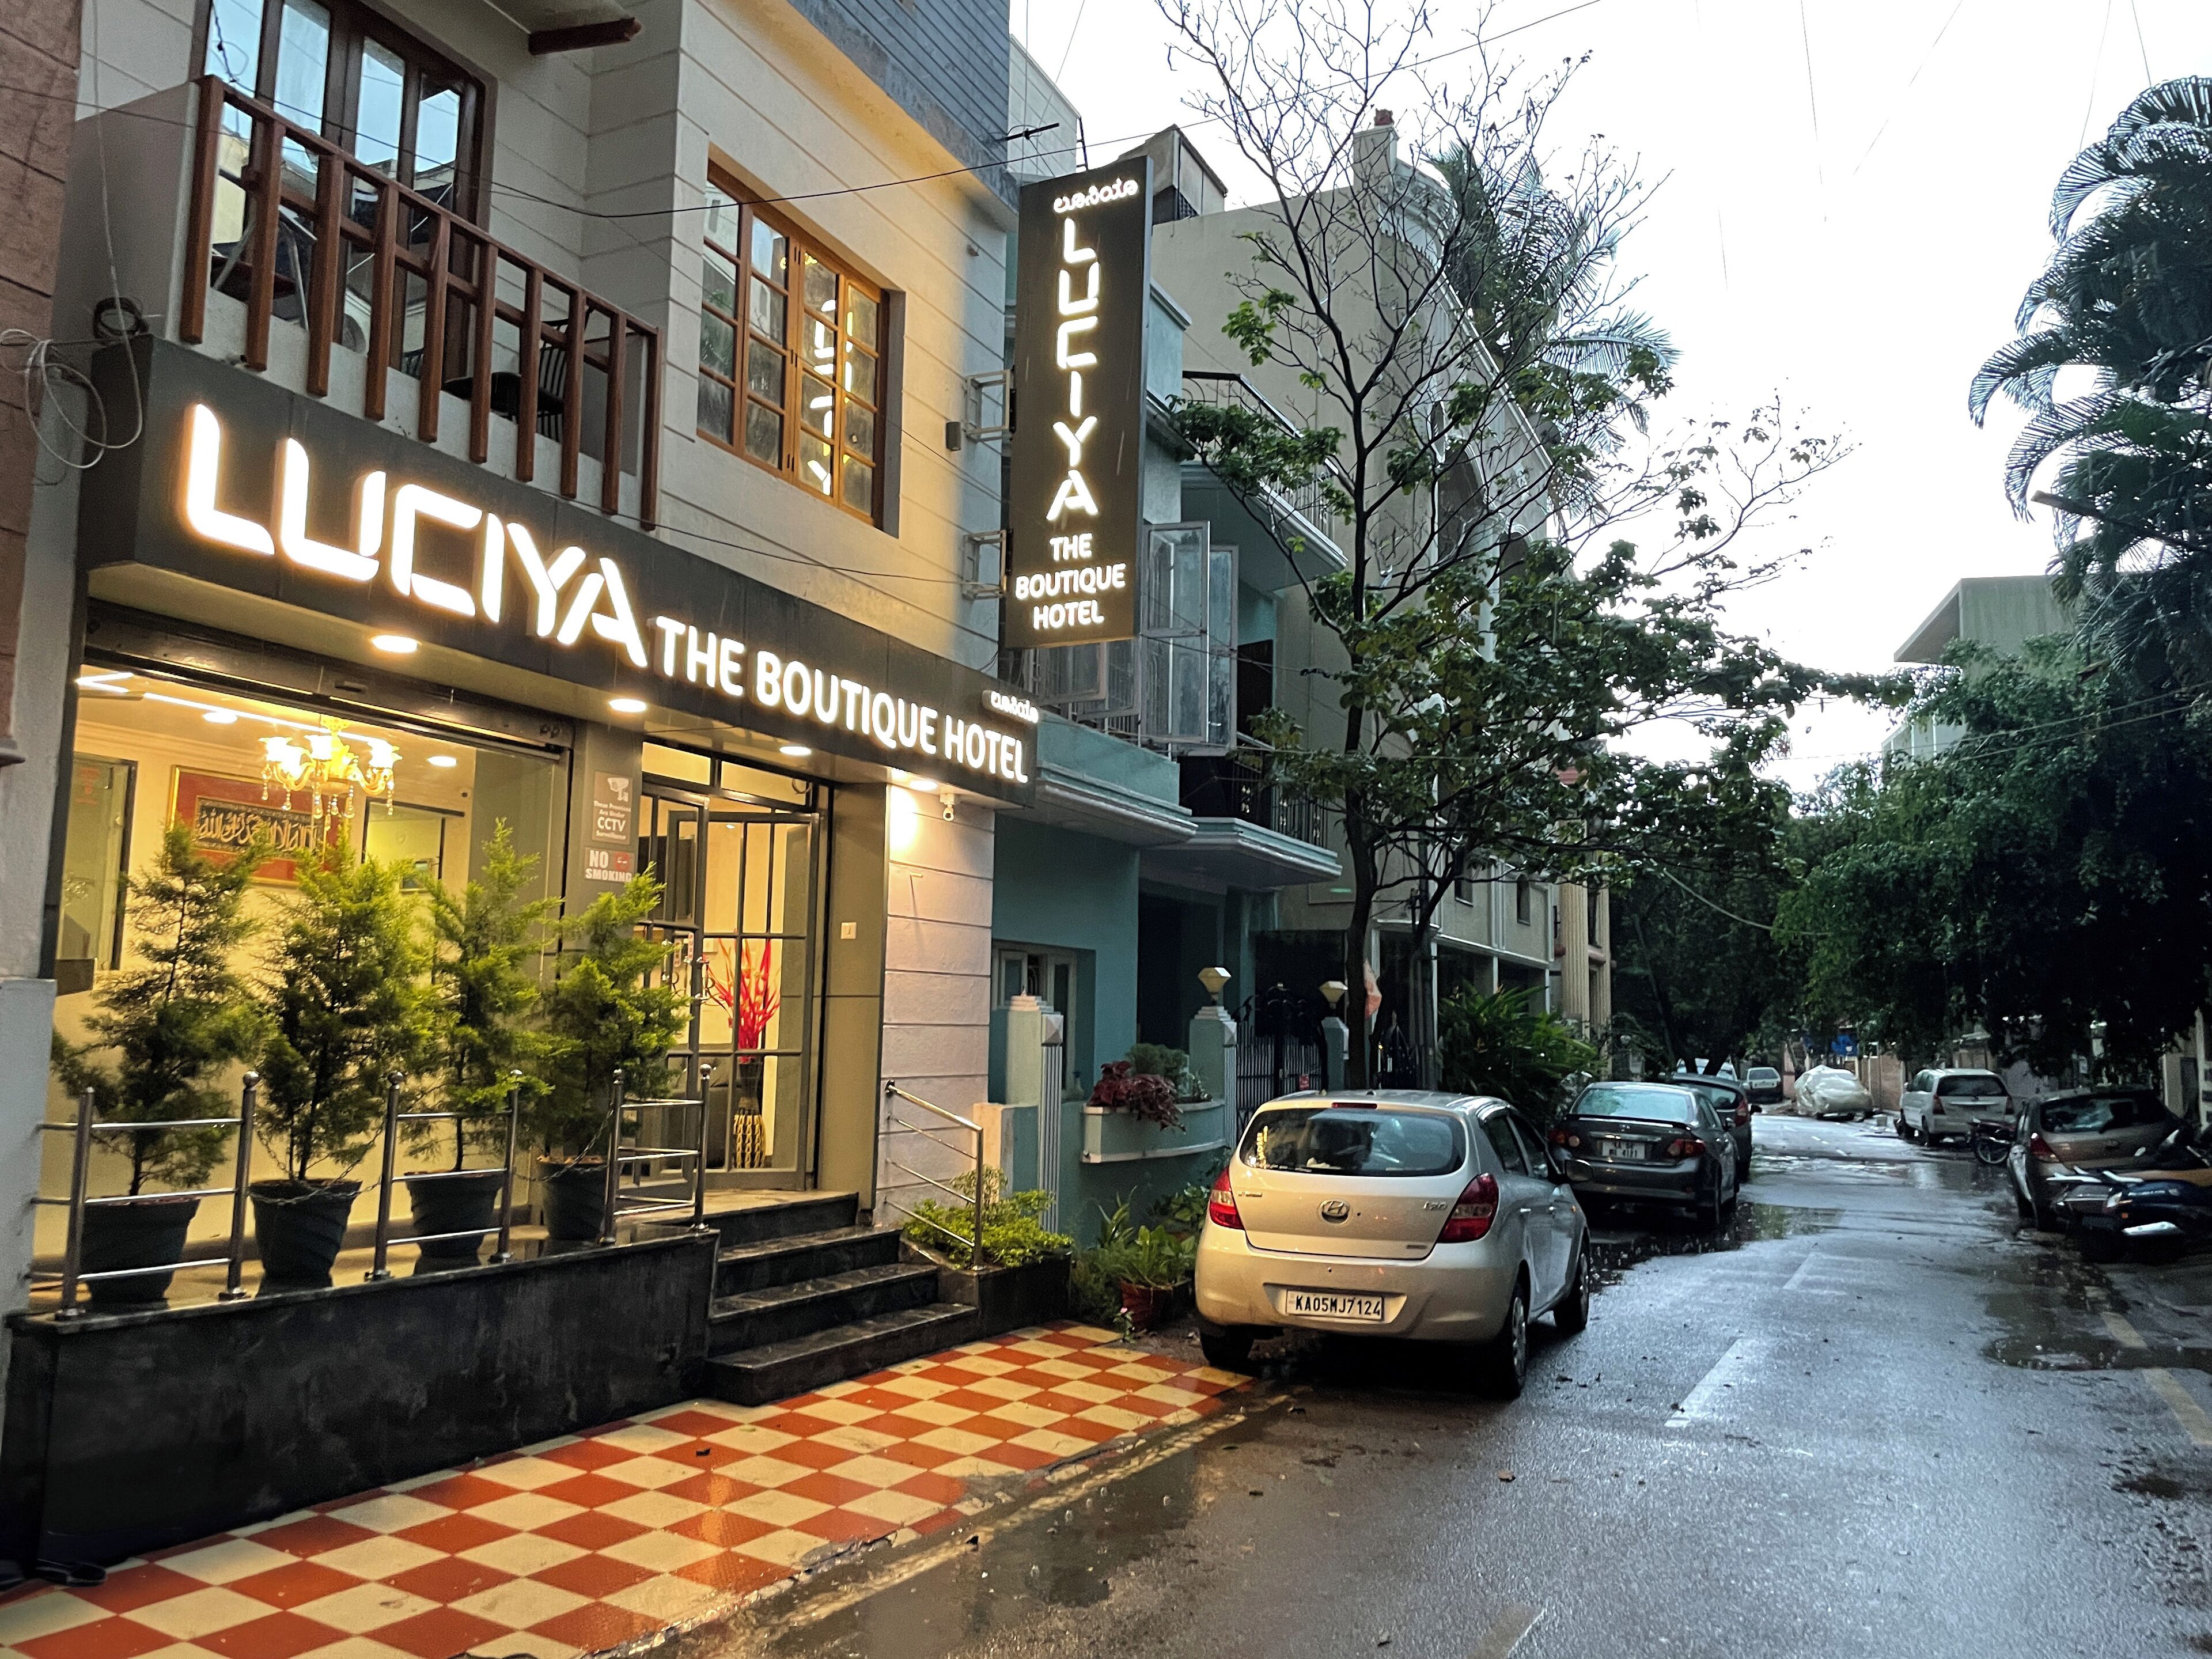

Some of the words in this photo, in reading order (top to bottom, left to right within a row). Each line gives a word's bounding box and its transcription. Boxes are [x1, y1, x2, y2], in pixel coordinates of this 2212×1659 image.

[1053, 177, 1139, 214] ಲೂಸಿಯಾ
[1046, 217, 1100, 521] LUCIYA
[185, 403, 649, 668] LUCIYA
[1049, 532, 1093, 562] THE
[1014, 562, 1127, 600] BOUTIQUE
[1033, 599, 1105, 630] HOTEL
[656, 615, 745, 697] THE
[755, 650, 938, 755] BOUTIQUE
[944, 714, 1028, 784] HOTEL
[597, 816, 626, 832] CCTV
[585, 868, 632, 882] SMOKING
[589, 850, 609, 869] NO
[1296, 1294, 1381, 1316] KA05MJ7124
